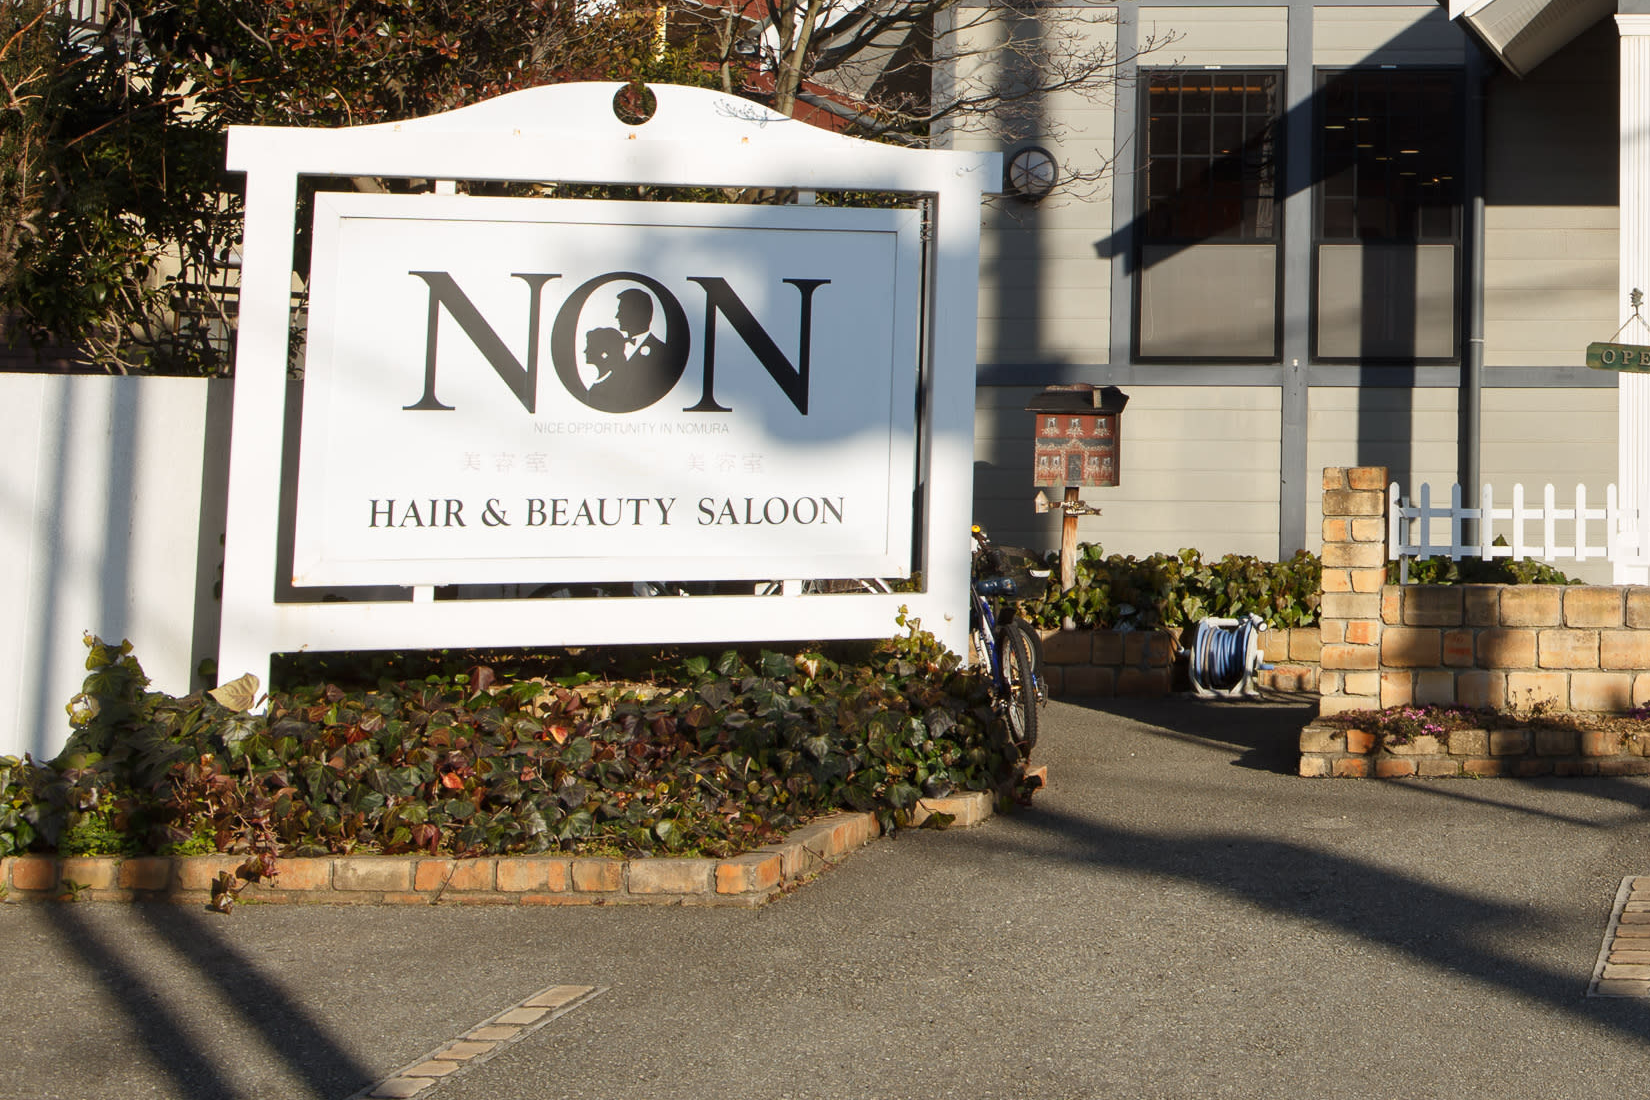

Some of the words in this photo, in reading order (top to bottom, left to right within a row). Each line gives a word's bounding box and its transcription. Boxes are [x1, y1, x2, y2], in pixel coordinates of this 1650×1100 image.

[402, 270, 832, 415] NON
[534, 422, 564, 435] NICE
[567, 422, 656, 436] OPPORTUNITY
[659, 423, 672, 436] IN
[677, 423, 729, 436] NOMURA
[369, 499, 466, 528] HAIR
[481, 498, 511, 527] &
[526, 497, 676, 527] BEAUTY
[697, 496, 844, 526] SALOON
